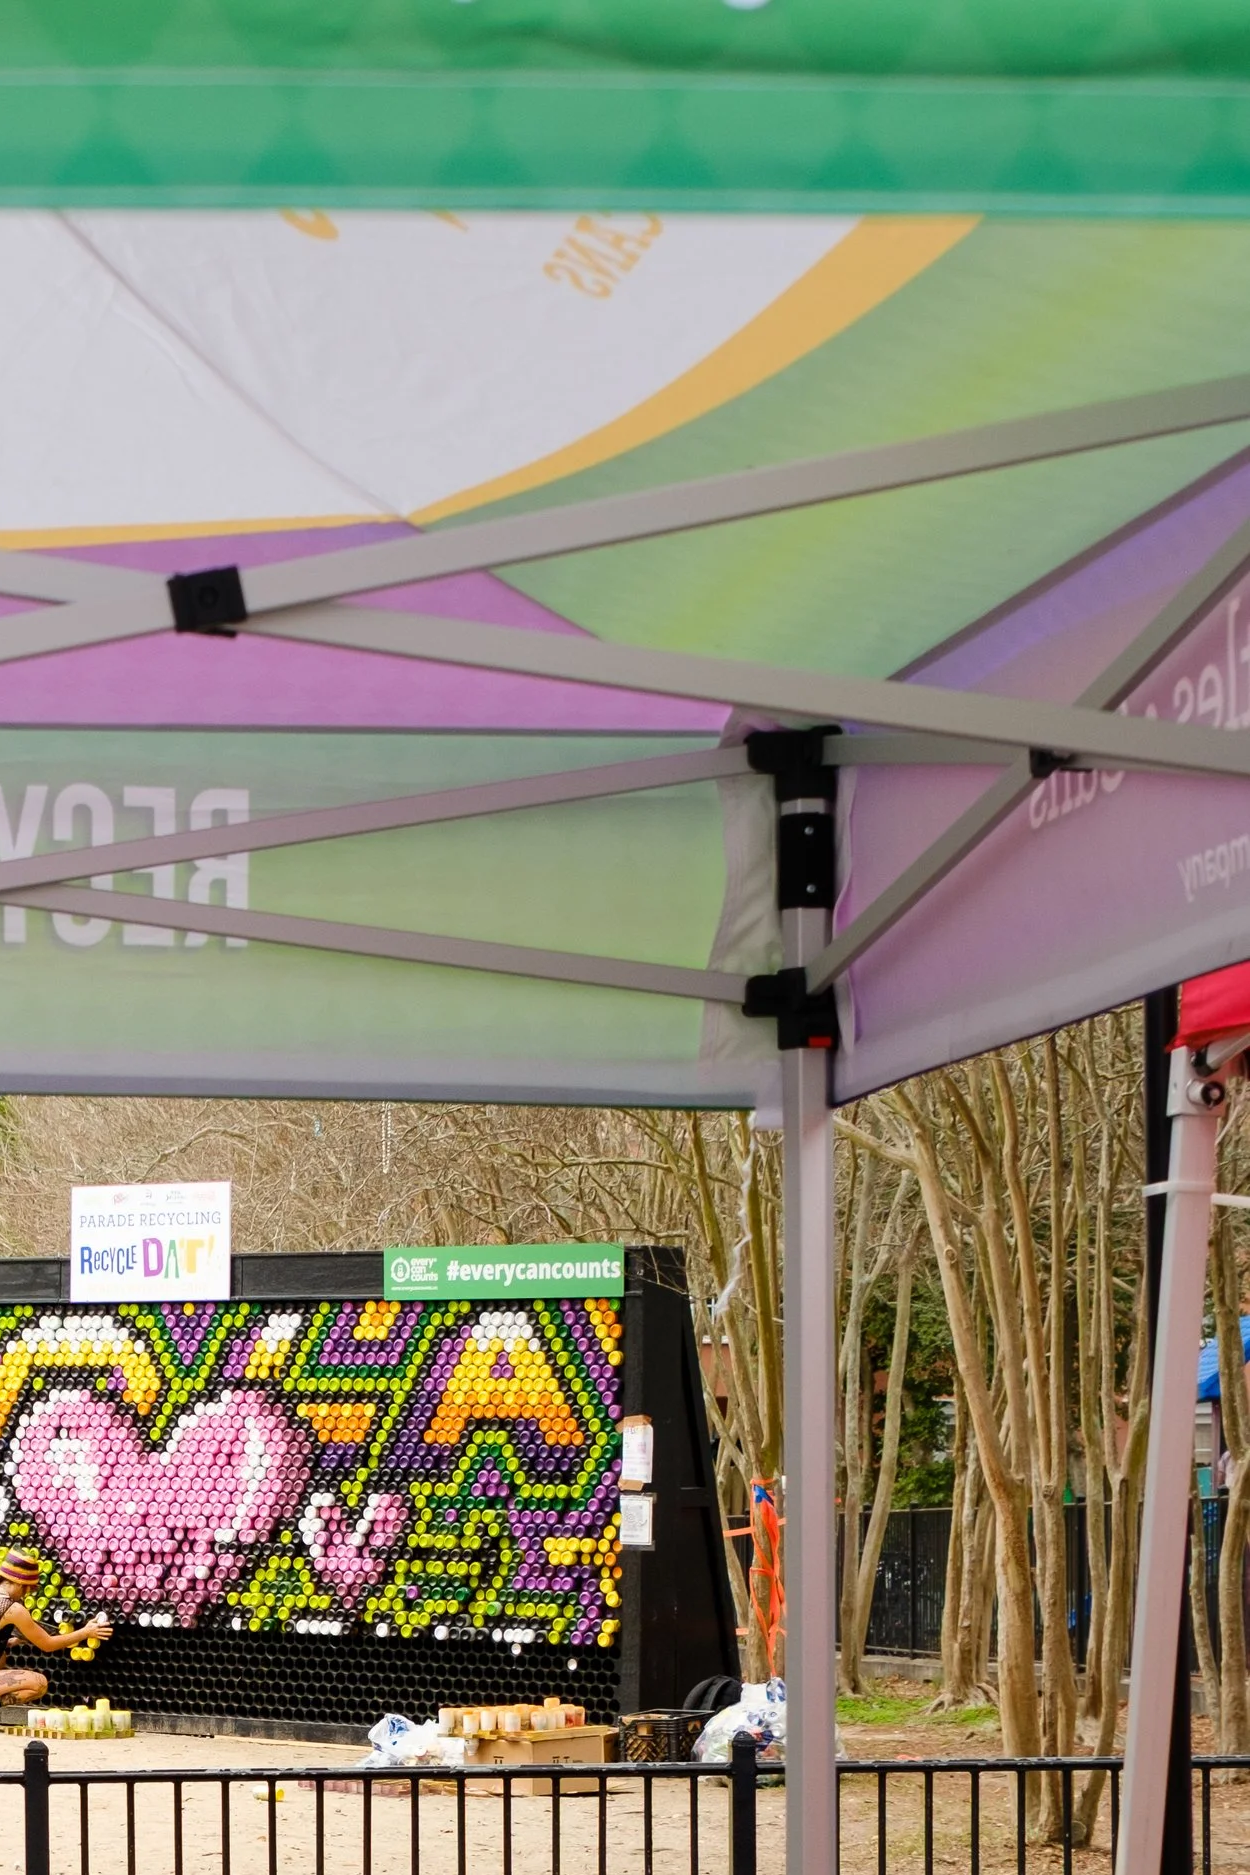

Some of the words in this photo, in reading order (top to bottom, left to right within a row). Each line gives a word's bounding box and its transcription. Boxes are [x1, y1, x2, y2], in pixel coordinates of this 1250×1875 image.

[79, 1214, 134, 1228] PARADE
[140, 1211, 221, 1227] RECYCLING
[446, 1258, 621, 1286] #everycancounts
